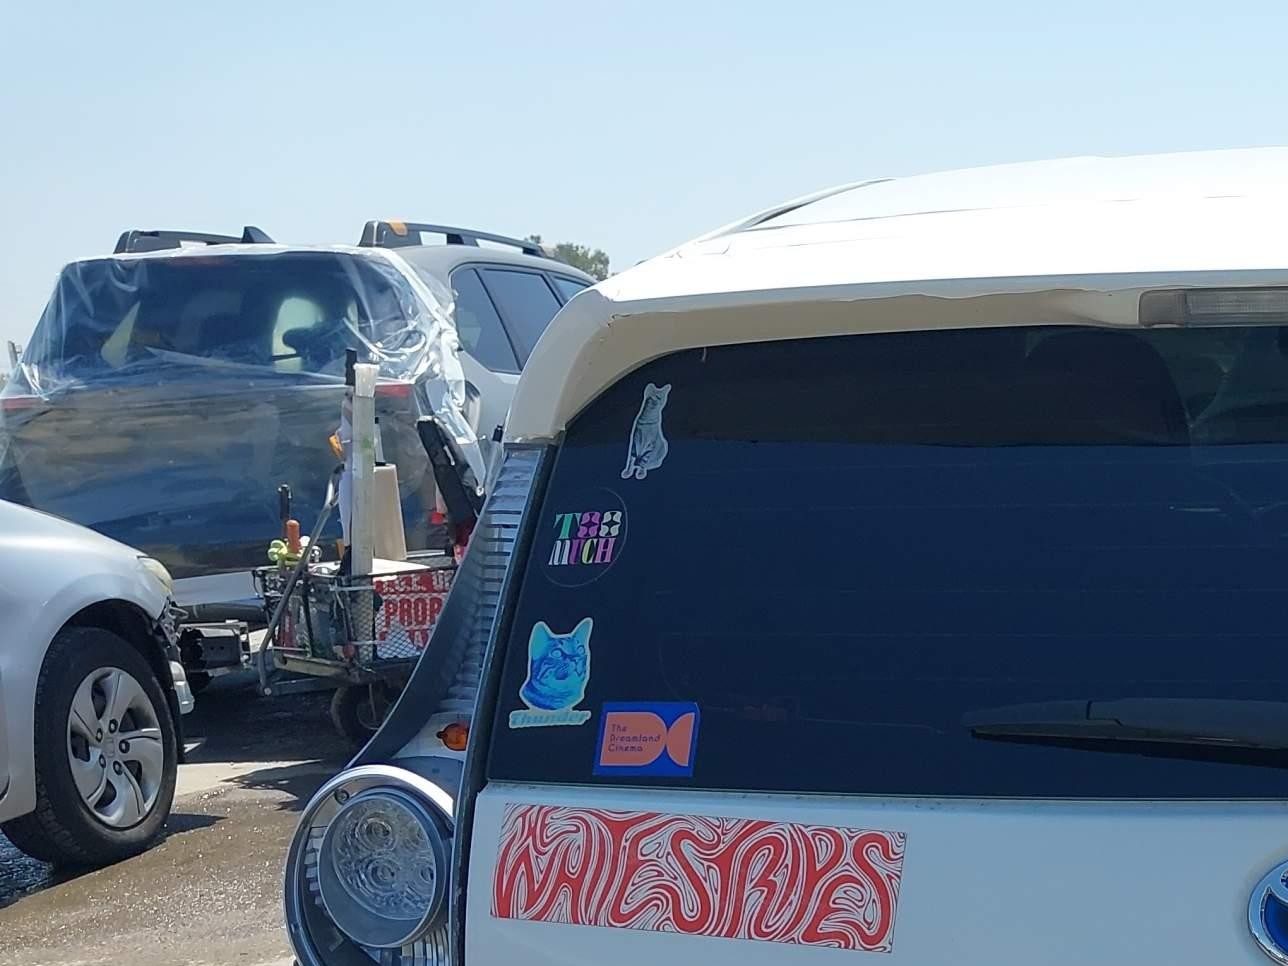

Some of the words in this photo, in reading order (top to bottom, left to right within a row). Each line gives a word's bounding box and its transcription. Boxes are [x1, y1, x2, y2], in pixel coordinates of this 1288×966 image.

[548, 538, 617, 566] MUCH
[611, 724, 627, 732] The
[609, 734, 661, 742] Dreamland
[607, 744, 643, 752] Cinema
